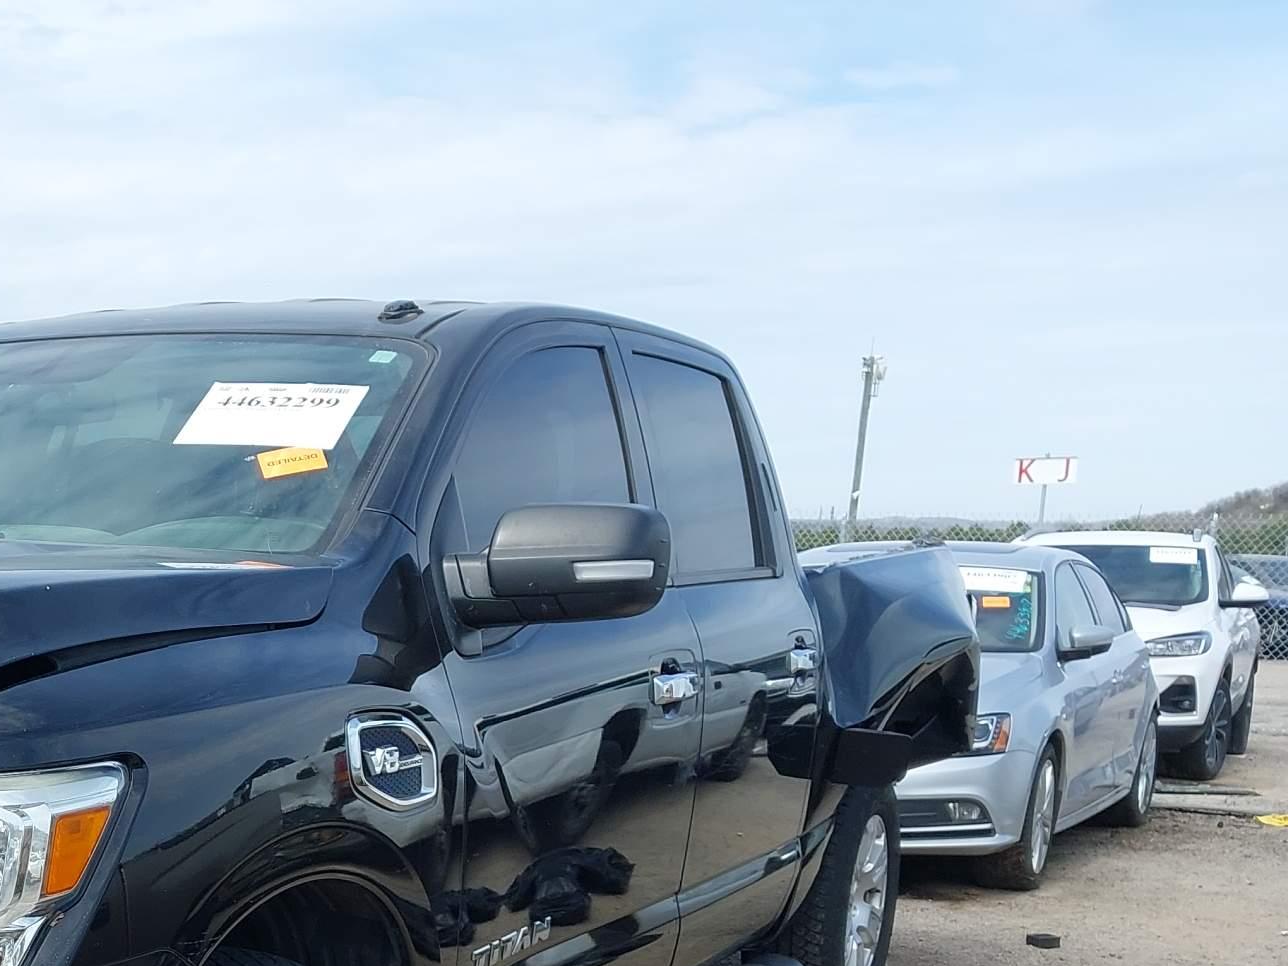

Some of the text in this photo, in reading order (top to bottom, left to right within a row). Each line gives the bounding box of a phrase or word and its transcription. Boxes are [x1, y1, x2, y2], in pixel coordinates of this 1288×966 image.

[218, 395, 341, 409] 44632299
[266, 452, 319, 467] DETAILED
[1017, 456, 1071, 484] K J
[362, 746, 400, 776] V8
